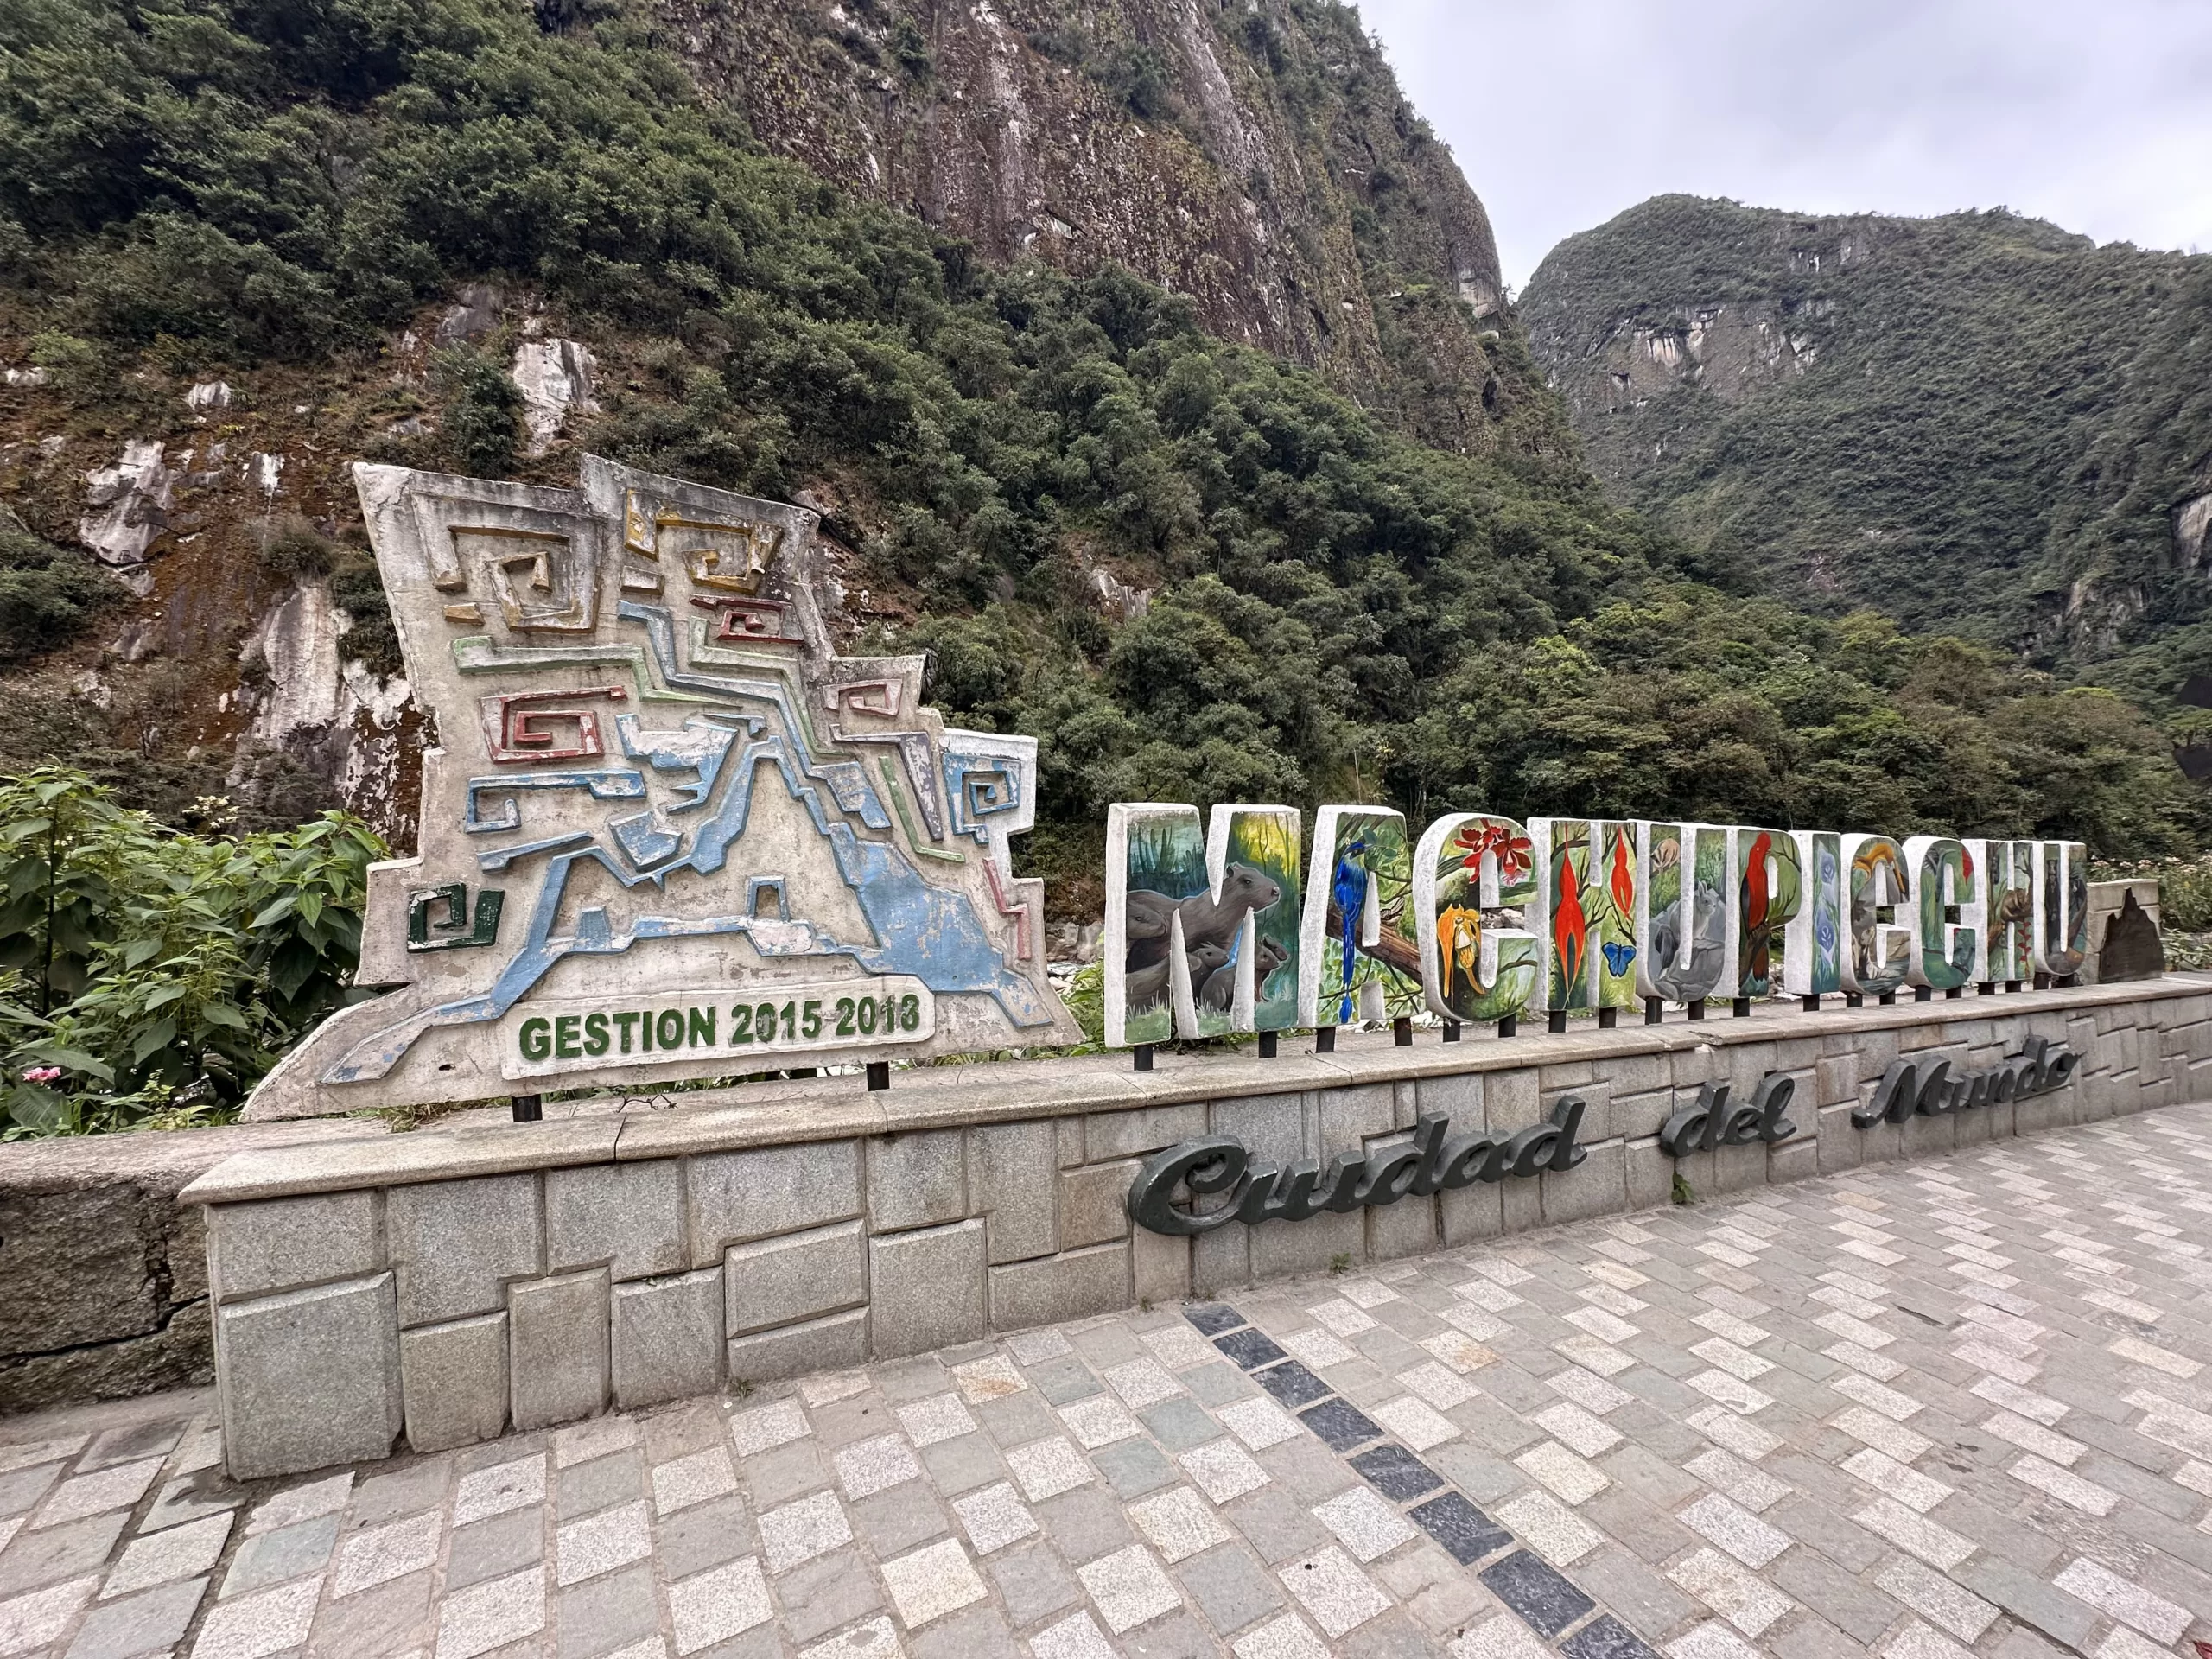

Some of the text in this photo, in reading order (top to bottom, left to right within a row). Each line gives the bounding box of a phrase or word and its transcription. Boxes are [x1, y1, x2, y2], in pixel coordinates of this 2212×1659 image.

[518, 1006, 716, 1061] GESTION
[1660, 1071, 1797, 1157] del
[1850, 1035, 2079, 1128] Mundo
